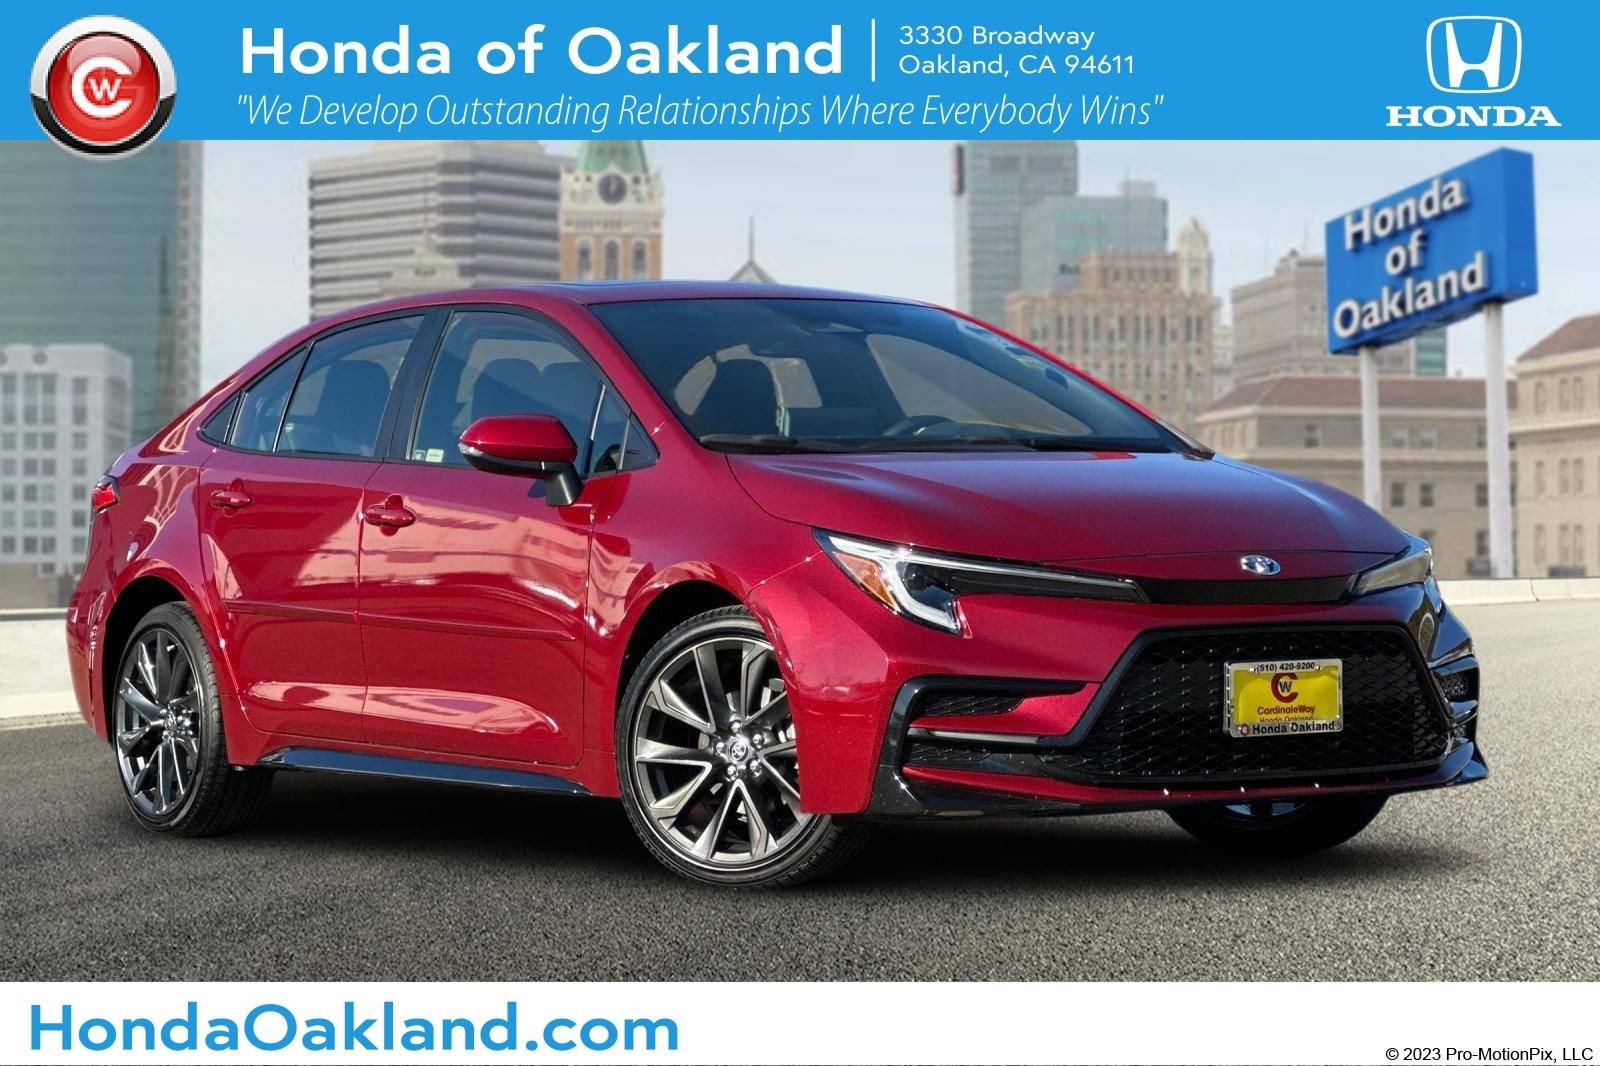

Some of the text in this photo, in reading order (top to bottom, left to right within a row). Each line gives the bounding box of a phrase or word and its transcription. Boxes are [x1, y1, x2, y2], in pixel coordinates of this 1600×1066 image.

[1343, 176, 1468, 251] Honda
[1385, 228, 1427, 275] of
[1333, 250, 1490, 338] Oakland
[1257, 662, 1316, 673] (510) 420-9200
[1257, 704, 1316, 715] CardinaleWay
[1252, 722, 1287, 735] Honda
[1291, 721, 1335, 733] Oakland
